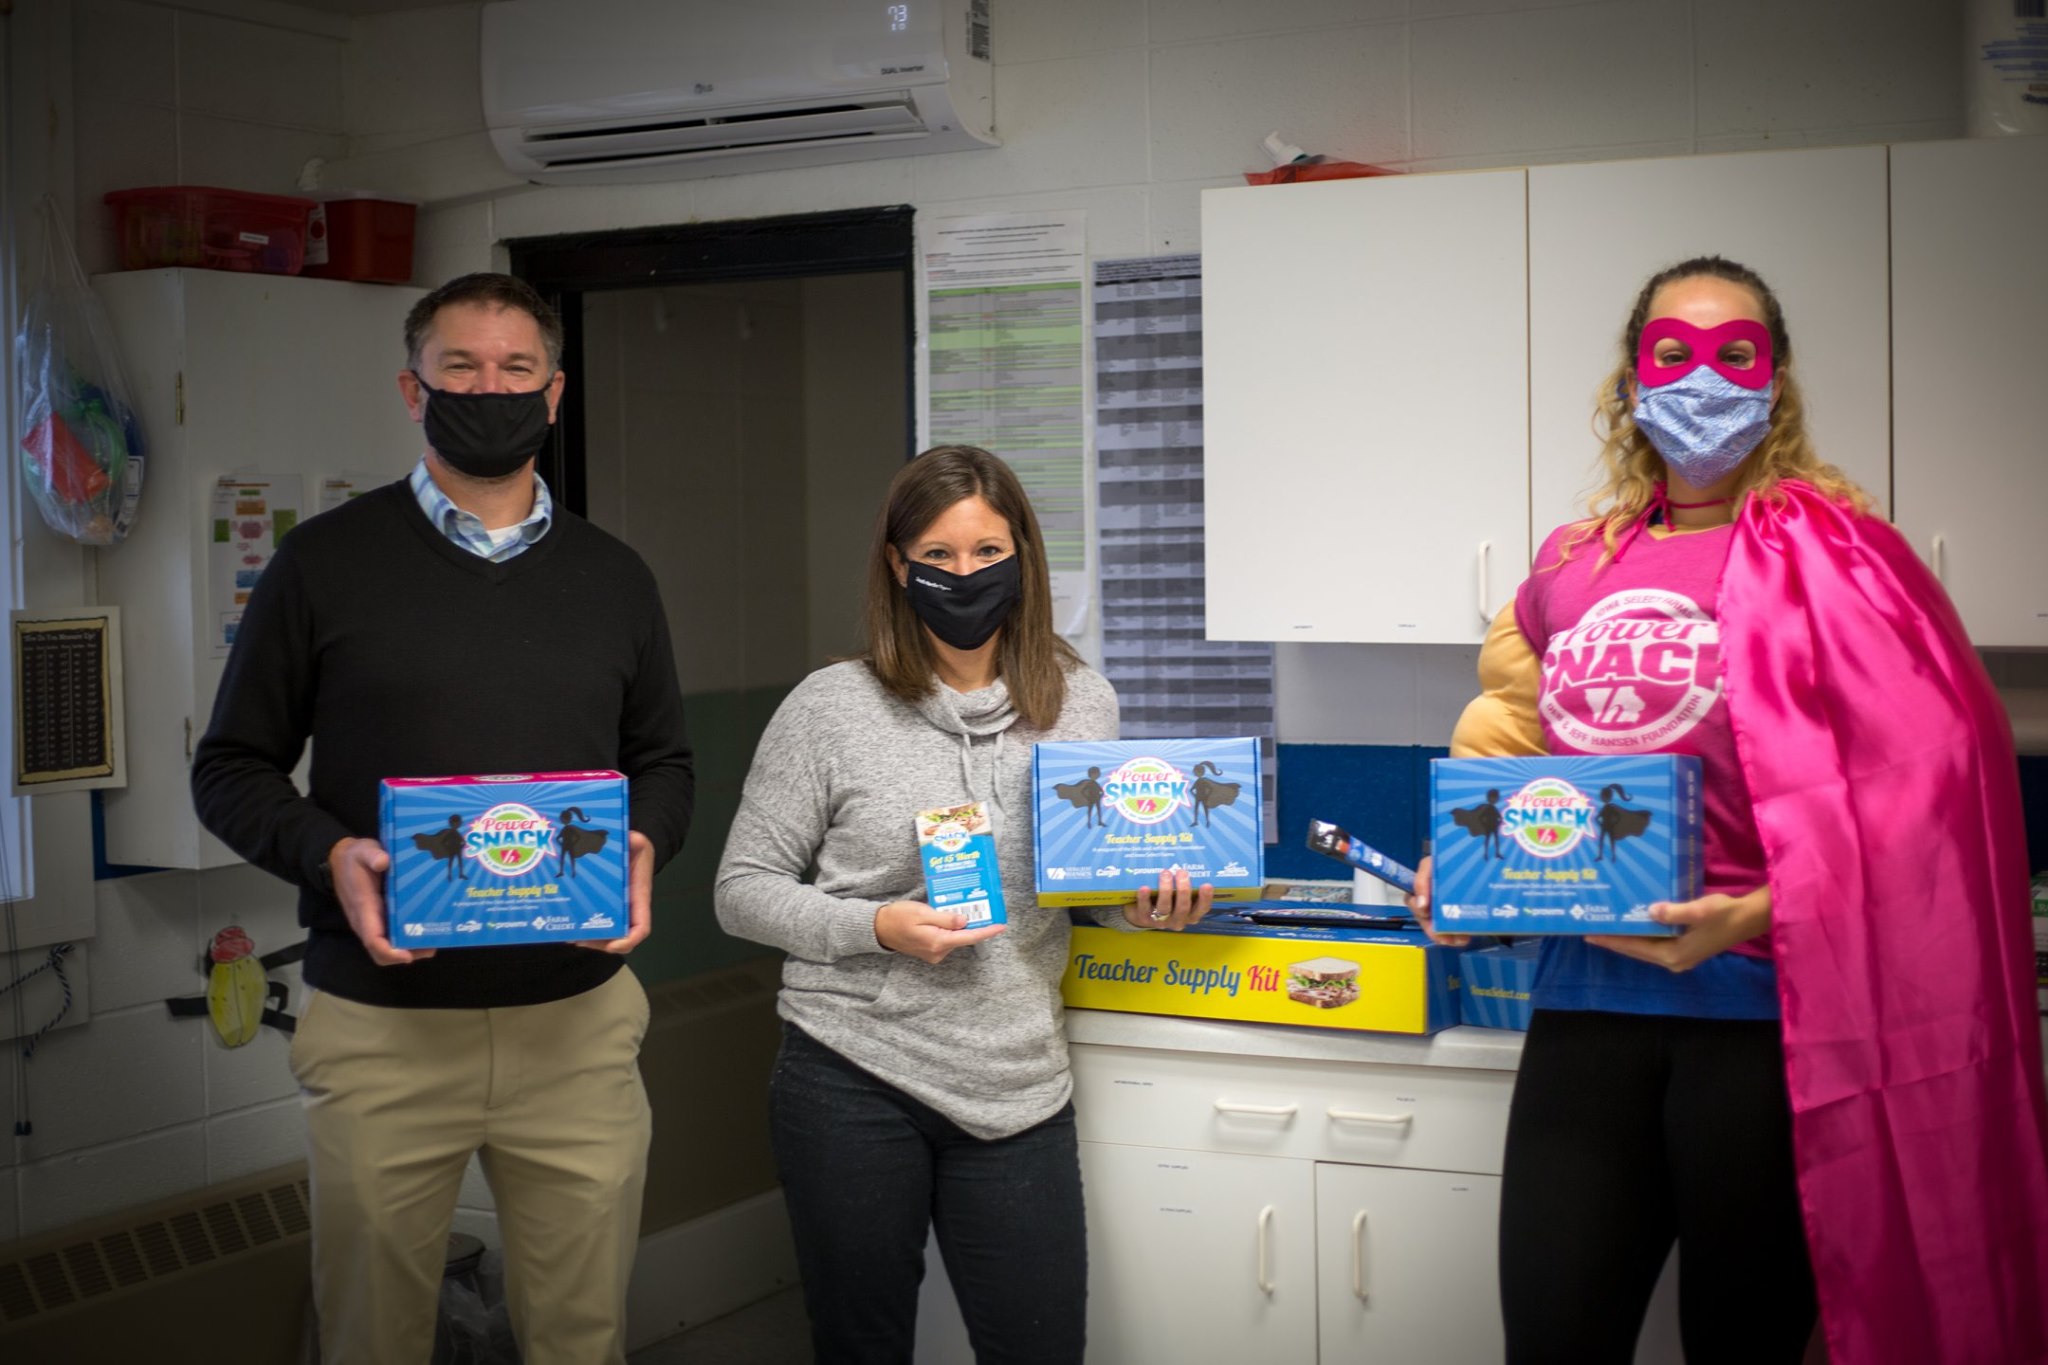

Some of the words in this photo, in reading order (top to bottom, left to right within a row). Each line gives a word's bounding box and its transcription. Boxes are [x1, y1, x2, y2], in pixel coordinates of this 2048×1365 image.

[1624, 596, 1661, 605] SELECT
[1662, 598, 1697, 619] FARMS
[1590, 734, 1640, 747] HANSEN
[1640, 693, 1702, 744] FOUNDATION
[1118, 769, 1173, 782] Power
[1105, 781, 1189, 804] SNACK
[1518, 793, 1578, 807] Power
[481, 817, 540, 831] Power
[1503, 807, 1592, 832] SNACK
[465, 829, 554, 853] SNACK
[1104, 833, 1143, 844] Teacher
[1144, 832, 1178, 846] Supply
[1178, 831, 1193, 843] Kit
[1544, 867, 1580, 883] Supply
[506, 885, 542, 898] Supply
[1074, 953, 1159, 984] Teacher
[1164, 959, 1241, 997] Supply
[1247, 964, 1281, 992] Kit
